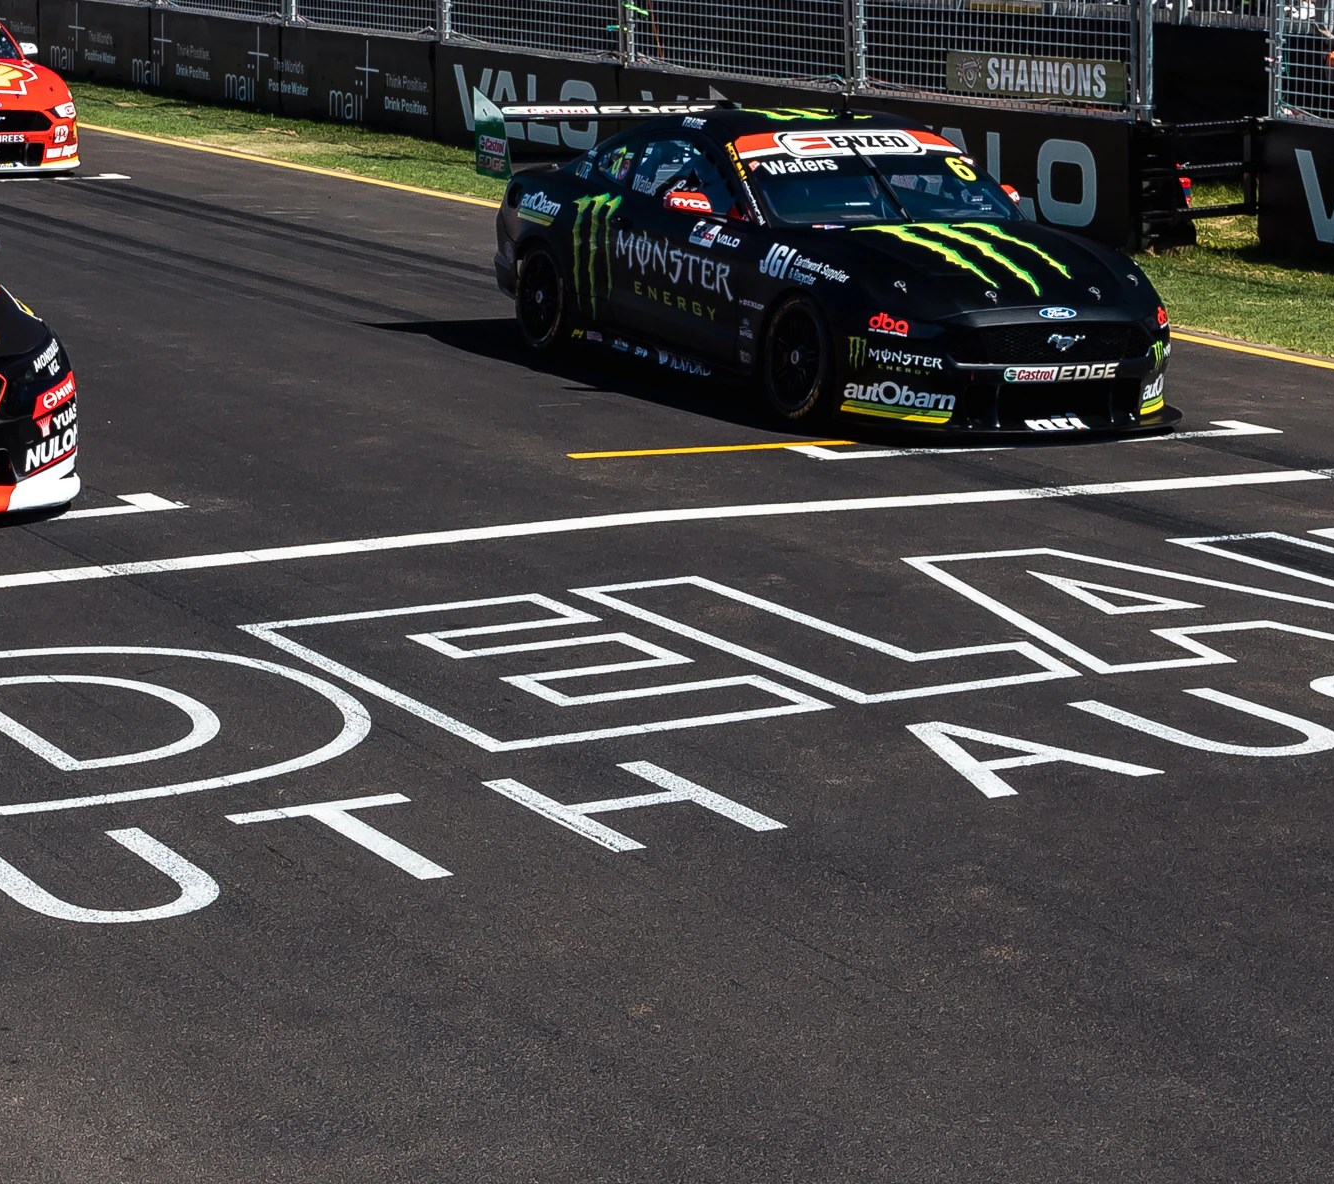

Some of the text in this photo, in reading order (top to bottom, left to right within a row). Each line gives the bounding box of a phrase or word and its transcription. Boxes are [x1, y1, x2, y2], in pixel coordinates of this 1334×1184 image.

[385, 72, 402, 89] Think
[985, 56, 1108, 101] SHANNONS
[384, 95, 402, 112] Drink
[681, 116, 708, 130] TRADIE
[827, 133, 910, 149] ENZED
[478, 138, 507, 172] Castrol EDGE
[760, 157, 839, 176] Waters
[944, 157, 977, 182] 6
[670, 197, 712, 210] RYCO
[716, 233, 741, 248] VALO
[615, 229, 734, 302] MONSTER
[759, 242, 797, 281] JGI
[793, 254, 851, 284] Earthwork Supplier
[633, 280, 717, 322] ENERGY
[868, 311, 909, 335] dba
[867, 346, 943, 370] MONSTER
[877, 363, 931, 376] ENERGY
[1017, 362, 1120, 382] Castrol EDGE
[55, 379, 74, 401] HIN
[52, 402, 77, 431] YUAS
